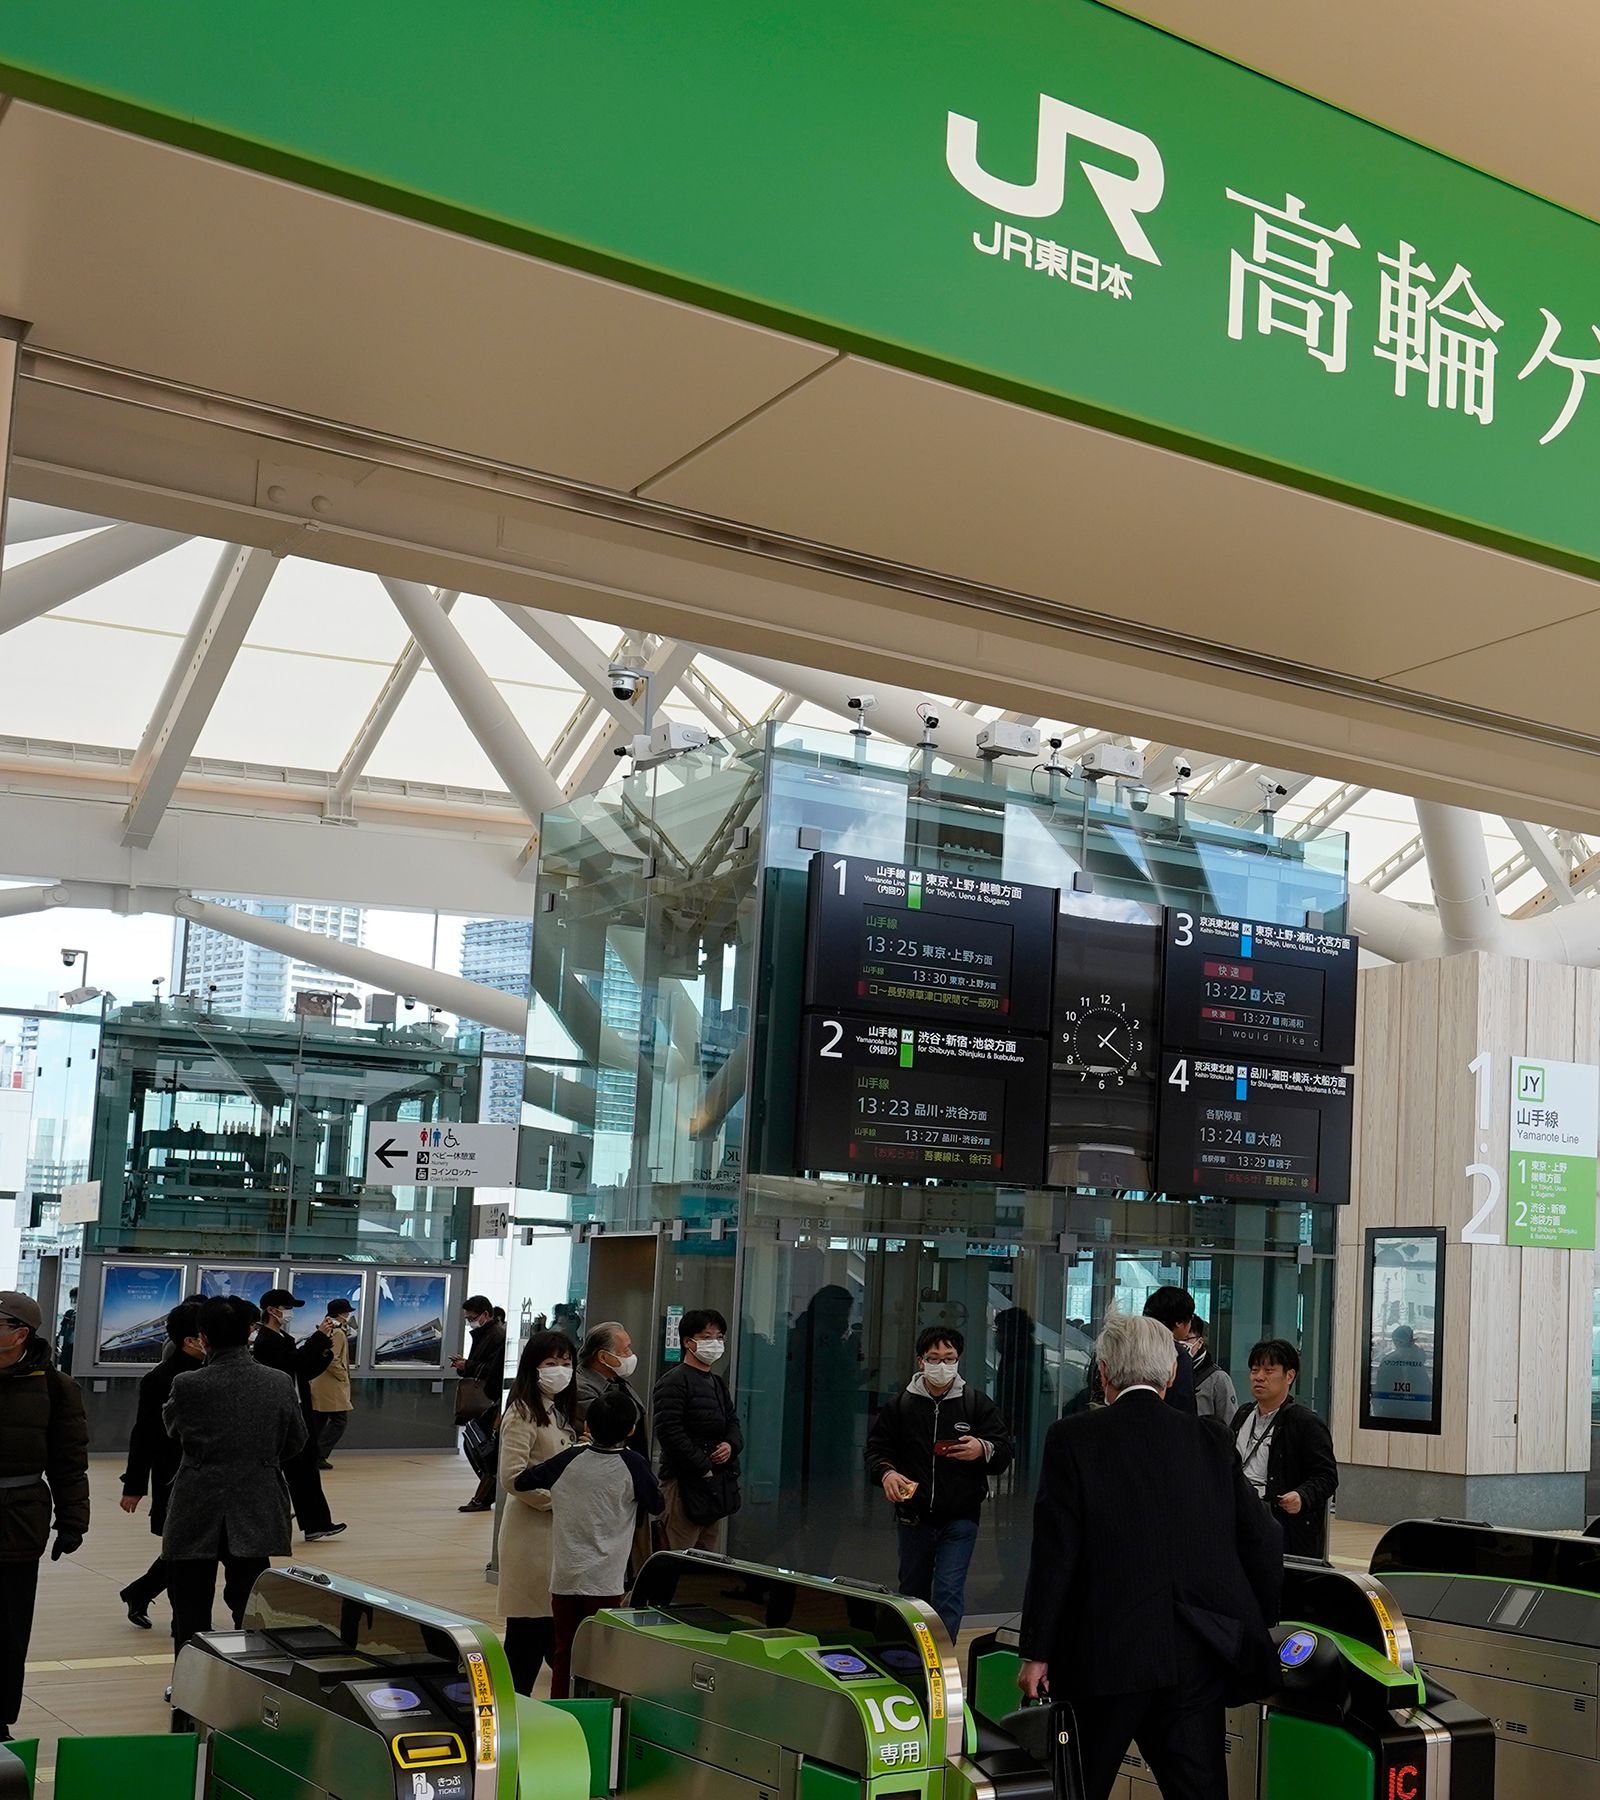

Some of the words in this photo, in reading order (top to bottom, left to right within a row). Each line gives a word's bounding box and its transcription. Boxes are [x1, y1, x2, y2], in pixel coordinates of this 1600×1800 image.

[946, 92, 1165, 267] JR
[972, 220, 1133, 300] JR東日本
[832, 859, 847, 896] 1
[864, 874, 892, 886] Yamanote
[876, 866, 906, 880] 山手線
[925, 887, 935, 895] for
[959, 892, 976, 901] Ueno
[983, 896, 1011, 906] Sugamo
[866, 915, 898, 929] 山手線
[1174, 912, 1194, 946] 3
[866, 935, 918, 957] 13:25
[922, 944, 993, 966] 東京・上野方面
[912, 970, 947, 985] 13:30
[1100, 994, 1111, 1005] 12
[1204, 982, 1247, 1001] 13:22
[1262, 990, 1286, 1006] 大宮
[1080, 997, 1090, 1007] 11
[1121, 1003, 1126, 1012] 1
[1065, 1011, 1077, 1021] 10
[1242, 1012, 1271, 1025] 13:27
[868, 1026, 898, 1038] 山手線
[1133, 1020, 1140, 1029] 2
[819, 1020, 844, 1058] 2
[855, 1035, 884, 1045] Yamanote
[918, 1031, 1017, 1054] 渋谷・新宿・池袋方面
[1062, 1033, 1070, 1042] 9
[1232, 1028, 1269, 1041] would
[1278, 1030, 1305, 1046] like
[918, 1045, 928, 1053] for
[928, 1046, 957, 1056] Shibuya,
[957, 1049, 986, 1059] Shinjuku
[993, 1054, 1025, 1063] Ikebukuro
[1136, 1041, 1143, 1051] 3
[1066, 1055, 1074, 1064] 8
[1130, 1062, 1137, 1071] 4
[857, 1076, 890, 1090] 山手線
[1080, 1072, 1087, 1081] 7
[1117, 1076, 1124, 1086] 5
[1168, 1059, 1190, 1092] 4
[1098, 1080, 1105, 1090] 6
[1467, 1051, 1491, 1130] 1
[1522, 1075, 1540, 1093] JY
[858, 1097, 909, 1117] 13:23
[914, 1103, 988, 1121] 品川・渋谷方面
[1517, 1108, 1559, 1129] 山手線
[905, 1129, 939, 1143] 13:27
[1200, 1126, 1242, 1145] 13:24
[1257, 1133, 1282, 1148] 大船
[1517, 1129, 1560, 1144] Yamanote
[1561, 1133, 1579, 1145] Line
[1238, 1156, 1266, 1168] 13:29
[431, 1168, 478, 1177] コインロッカー
[1518, 1159, 1526, 1184] 1
[1461, 1163, 1501, 1245] 2
[1515, 1201, 1528, 1226] 2
[864, 1695, 920, 1734] IC
[879, 1740, 921, 1766] 専用
[437, 1775, 461, 1787] きっぷ
[1388, 1765, 1418, 1800] IC
[438, 1786, 462, 1795] TICKET
